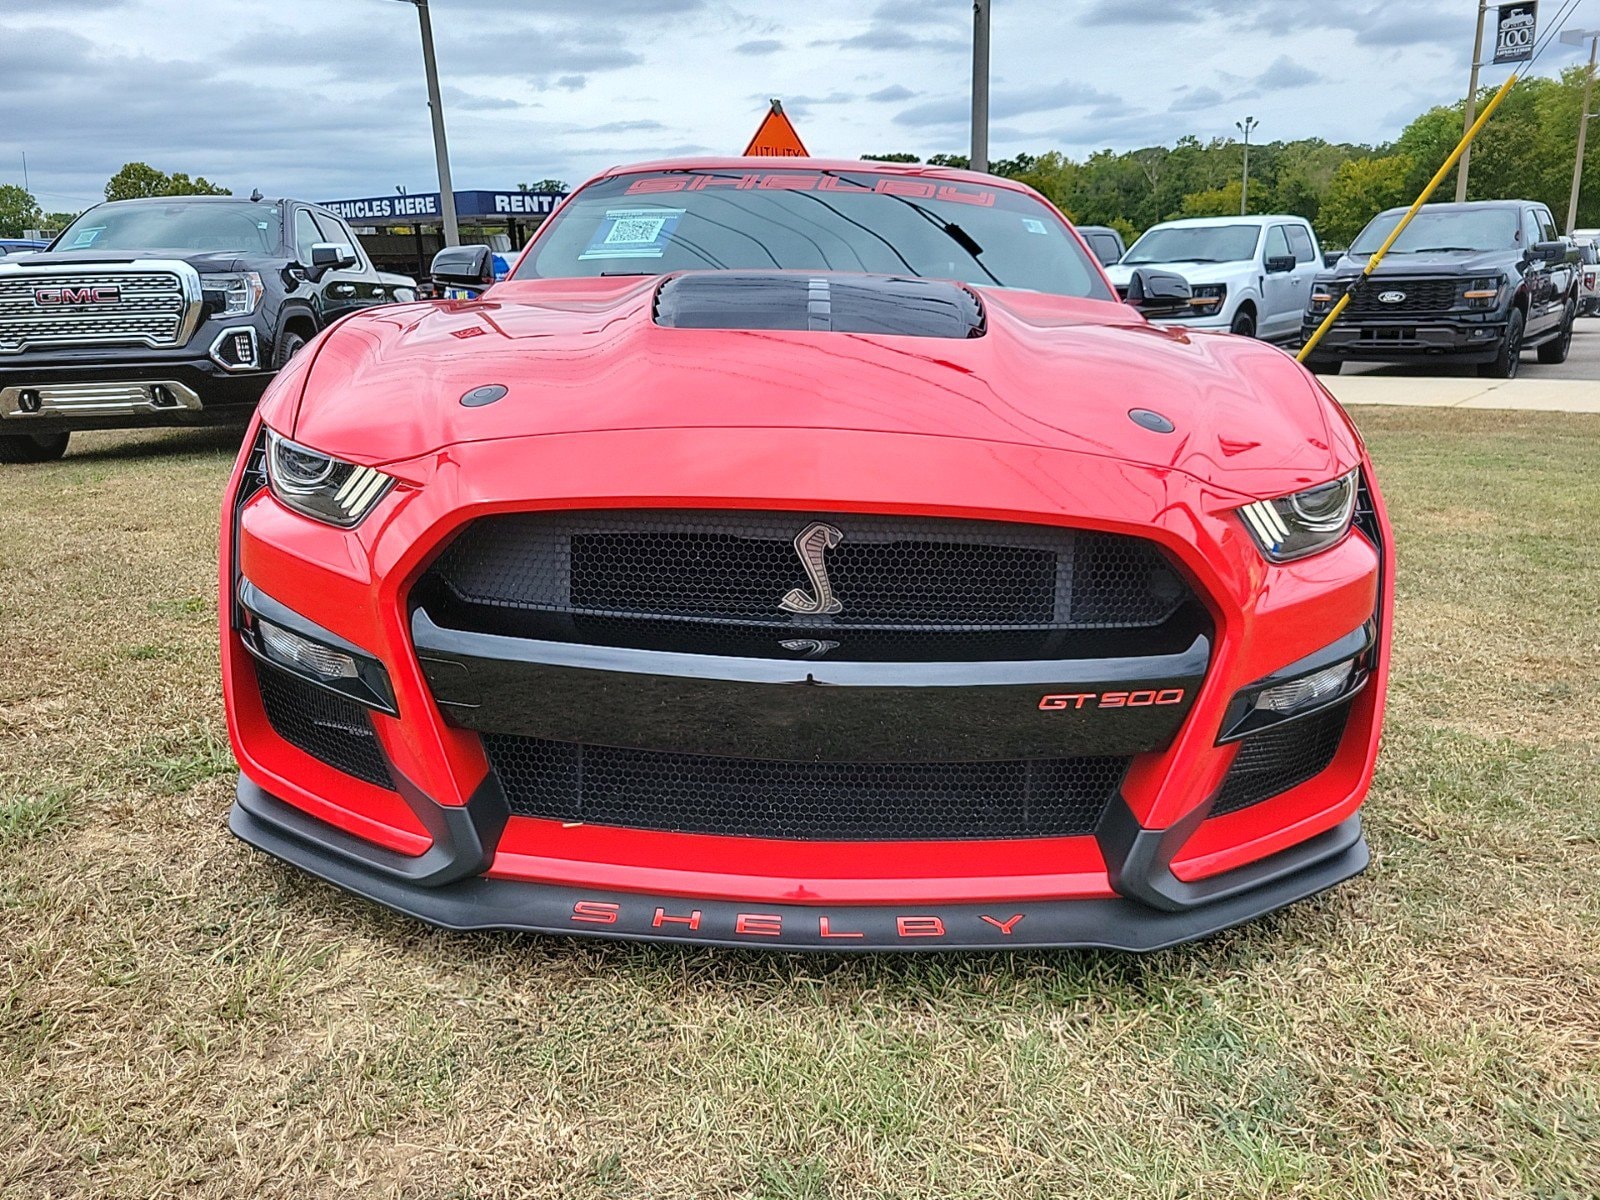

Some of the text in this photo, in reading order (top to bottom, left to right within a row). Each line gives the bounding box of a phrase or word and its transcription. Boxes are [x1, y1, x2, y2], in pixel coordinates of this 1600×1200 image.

[1499, 28, 1529, 48] 100
[755, 146, 801, 156] UTILITY
[623, 173, 996, 207] SHELBY
[394, 196, 436, 215] HERE
[36, 287, 119, 305] GMC
[570, 900, 1025, 939] SHELBY
